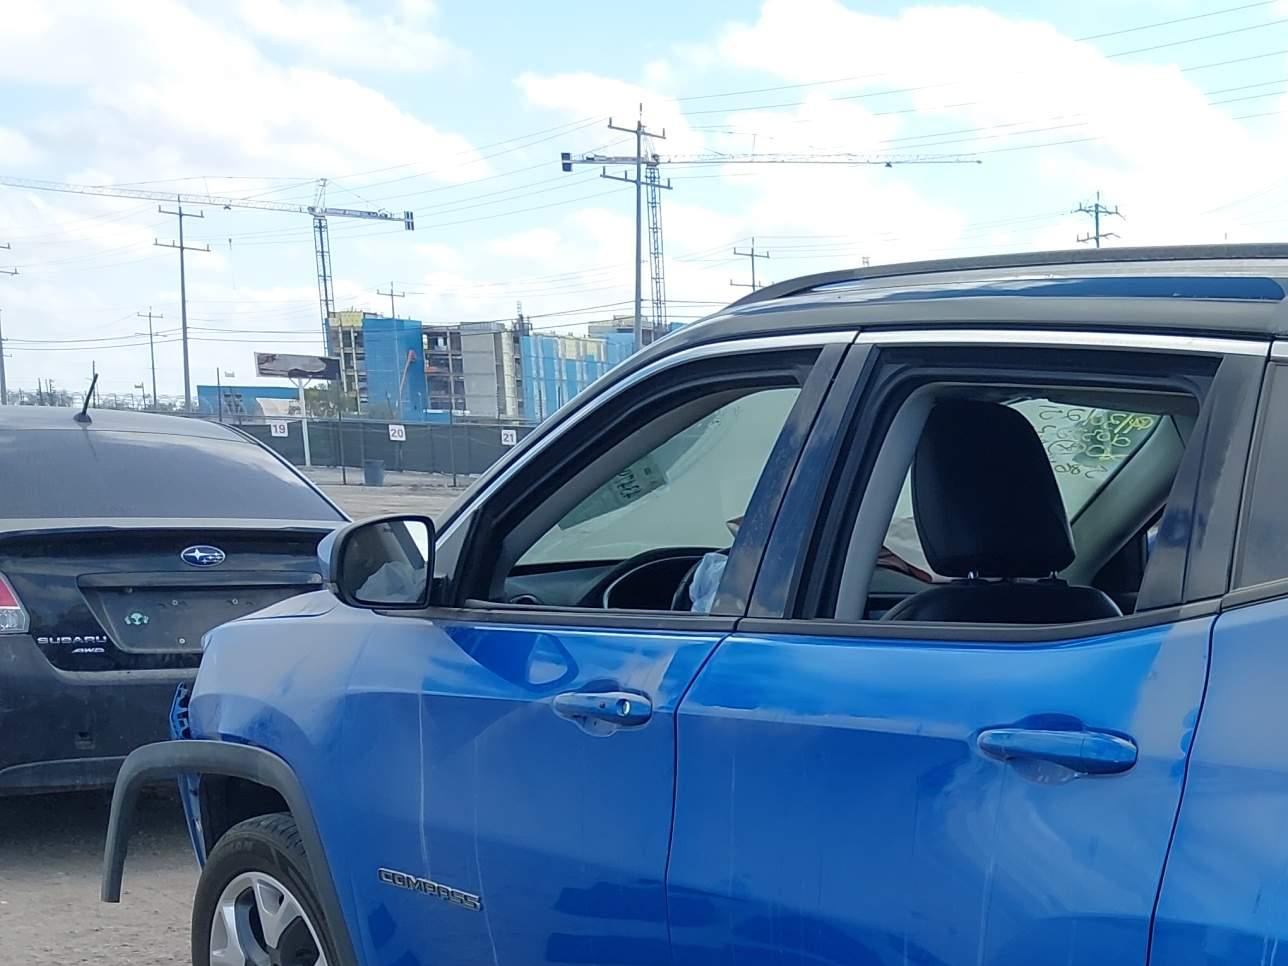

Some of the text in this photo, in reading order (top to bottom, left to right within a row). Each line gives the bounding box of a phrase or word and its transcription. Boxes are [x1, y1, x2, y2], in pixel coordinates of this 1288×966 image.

[272, 424, 286, 434] 19
[390, 427, 404, 438] 20
[503, 432, 514, 442] 21
[36, 635, 107, 644] SUBARU
[377, 867, 482, 912] COMPASS
